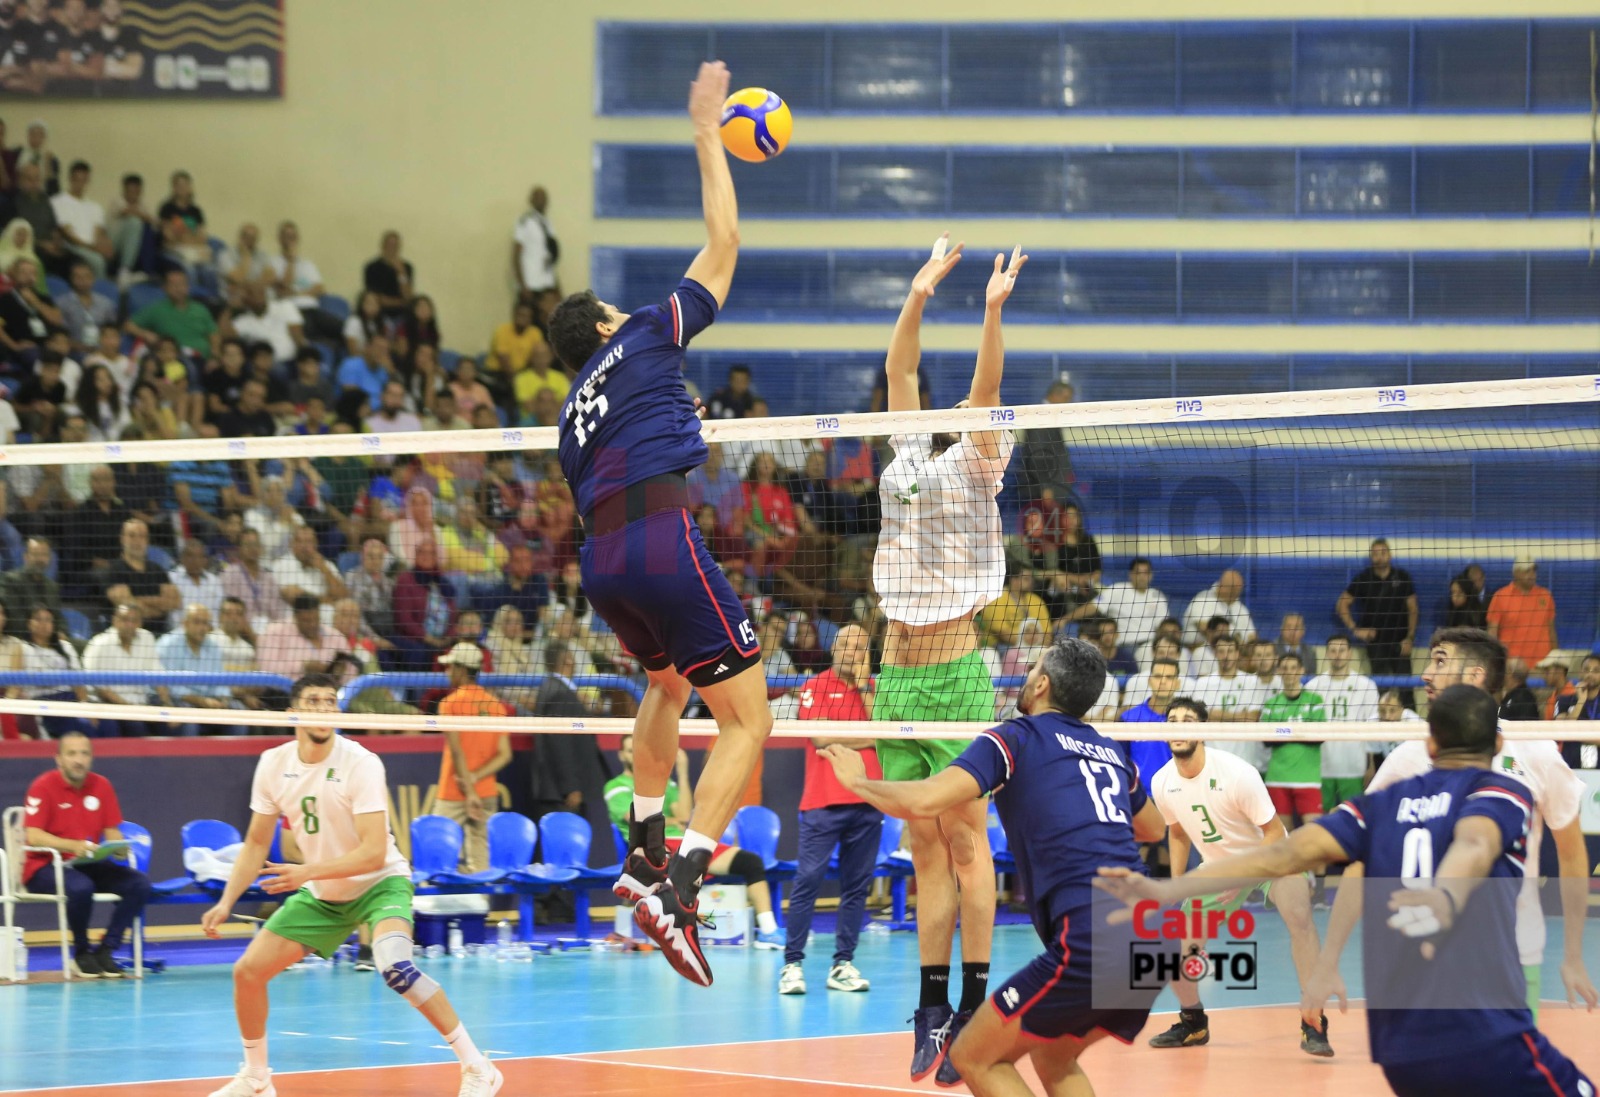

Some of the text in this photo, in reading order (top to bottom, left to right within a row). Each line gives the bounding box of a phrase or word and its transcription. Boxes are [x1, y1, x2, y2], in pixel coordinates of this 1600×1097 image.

[1176, 400, 1203, 412] FIVB
[1378, 390, 1407, 402] FIVB
[815, 417, 840, 429] FIVB
[990, 409, 1016, 421] FIVB
[738, 618, 755, 645] 15
[1055, 732, 1126, 769] HASSAN
[1079, 758, 1129, 824] 12
[301, 796, 320, 835] 8
[1191, 804, 1217, 837] 3
